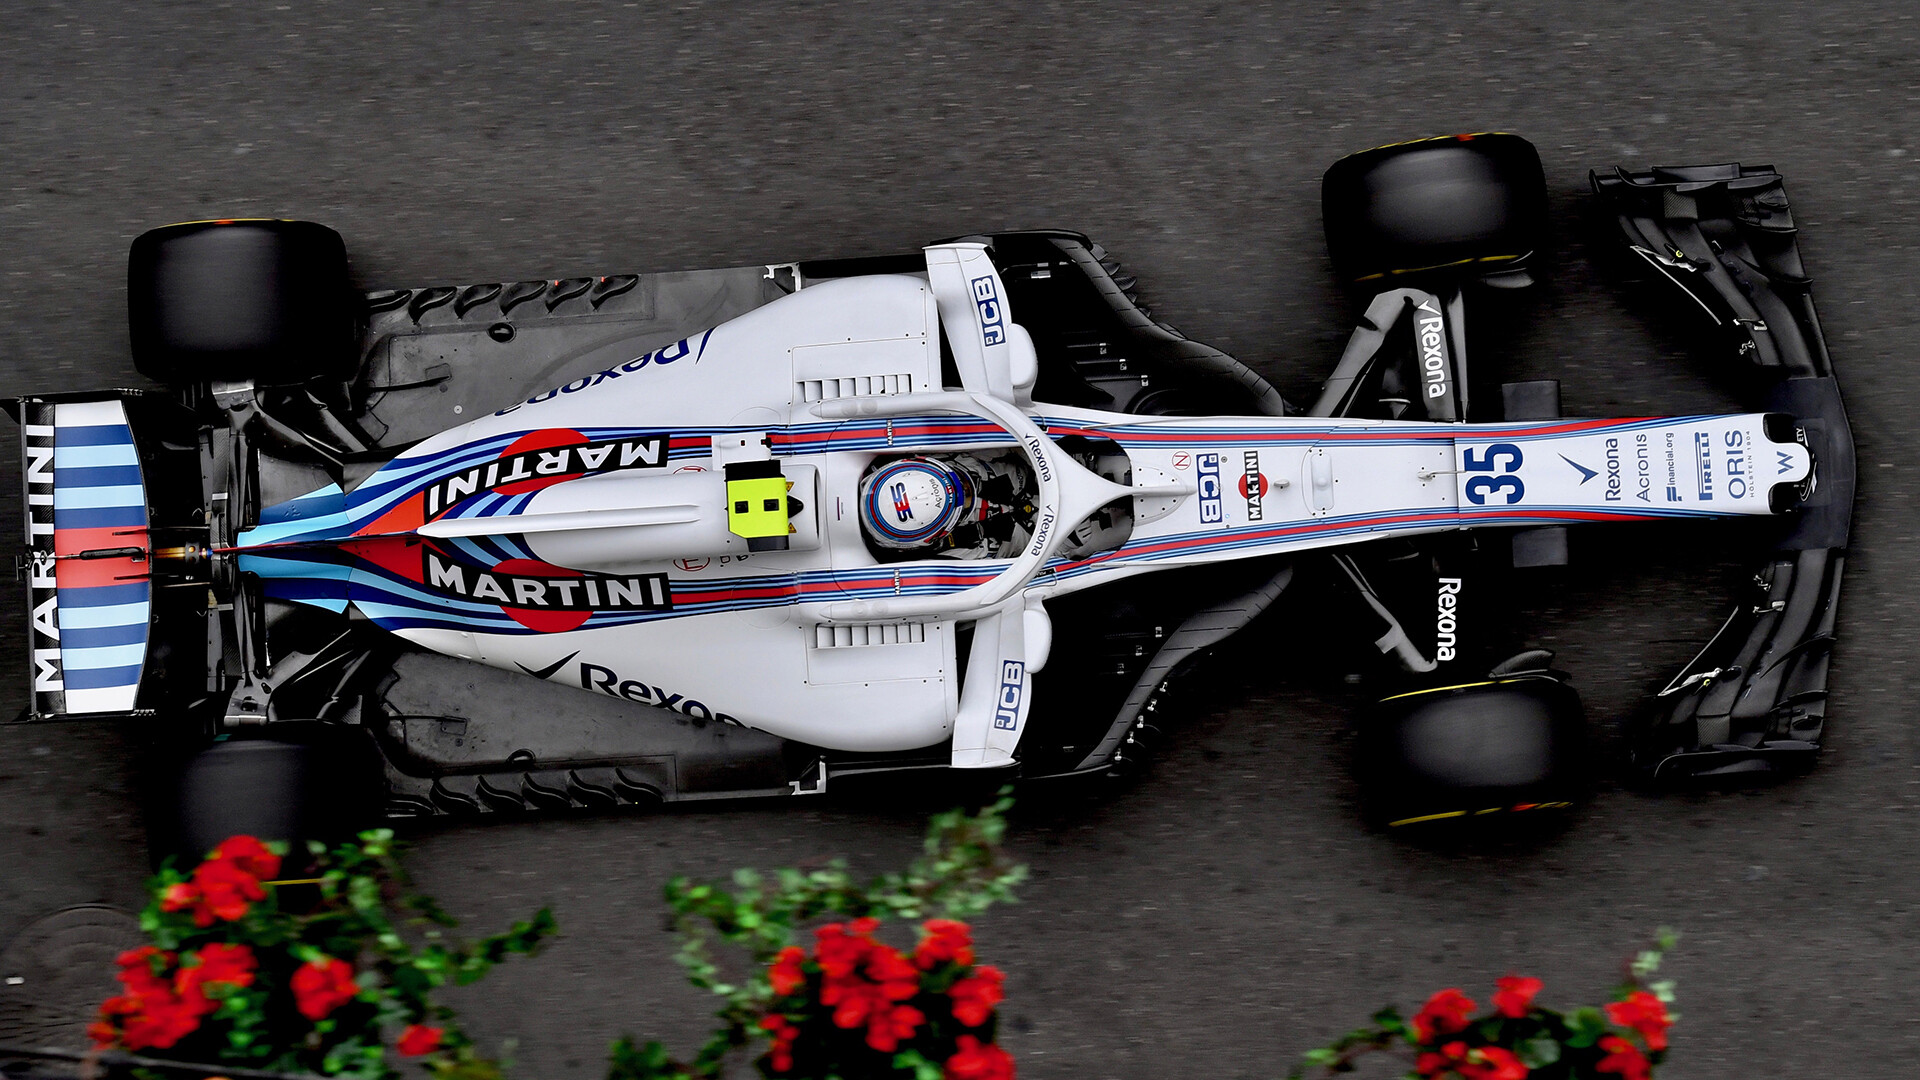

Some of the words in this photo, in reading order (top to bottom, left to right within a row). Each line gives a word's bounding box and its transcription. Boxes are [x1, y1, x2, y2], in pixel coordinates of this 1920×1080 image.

[973, 277, 1005, 344] JCB
[1420, 316, 1446, 398] Rexona
[429, 440, 661, 516] MARTINI
[1029, 439, 1052, 482] Rexona
[1198, 455, 1221, 522] JCB
[1245, 453, 1261, 519] MARTINI
[1464, 444, 1525, 505] 35
[1605, 438, 1621, 501] Rexona
[1636, 434, 1651, 502] Acronis
[1695, 432, 1713, 500] PIRELLI
[1725, 430, 1746, 499] ORIS
[26, 425, 64, 692] MARTINI
[1031, 514, 1055, 557] Rexona
[429, 554, 664, 606] MARTINI
[1437, 578, 1461, 661] Rexona
[997, 661, 1023, 730] JCB
